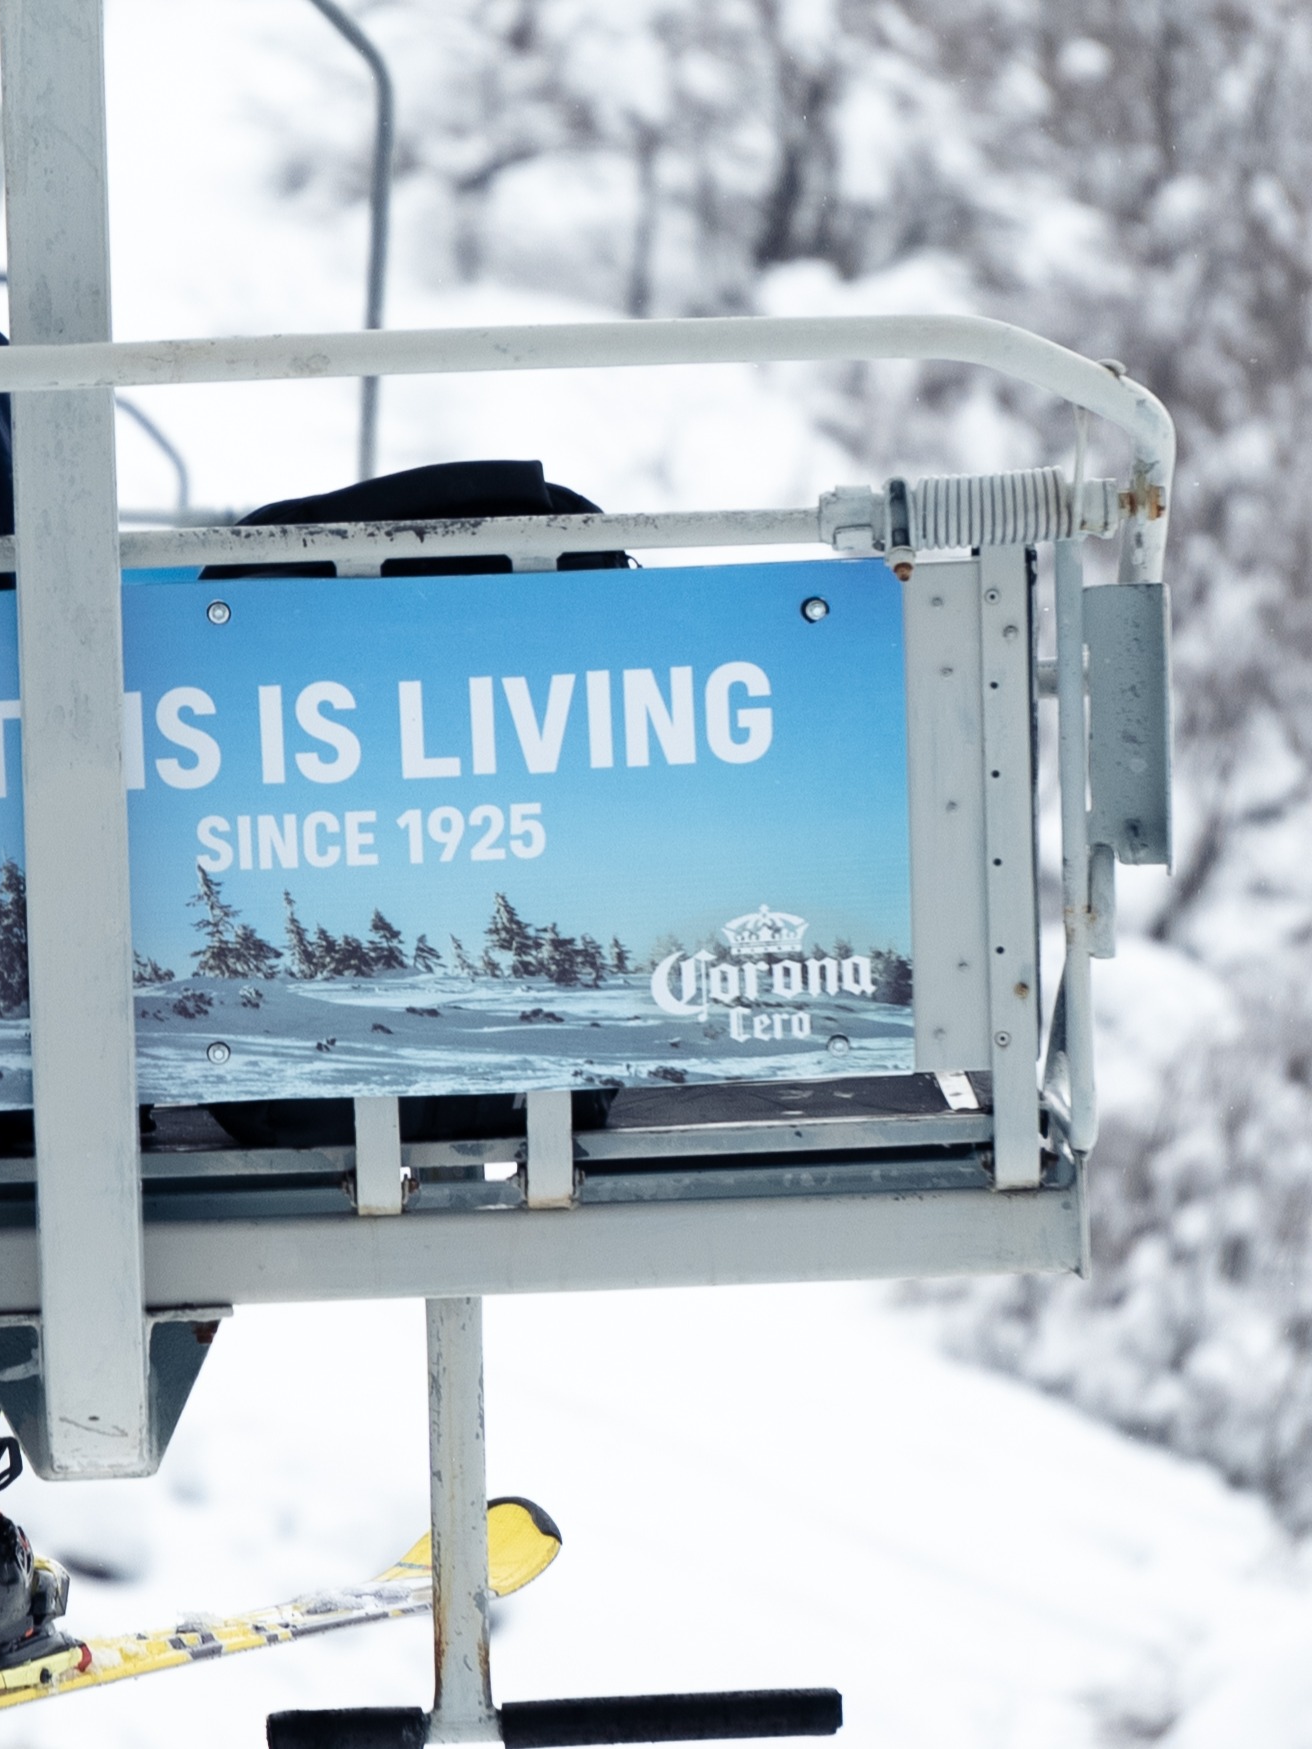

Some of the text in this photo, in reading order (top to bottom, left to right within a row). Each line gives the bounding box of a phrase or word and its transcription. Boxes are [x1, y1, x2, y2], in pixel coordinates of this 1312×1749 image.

[258, 681, 361, 785] IS
[398, 661, 773, 780] LIVING
[195, 803, 546, 873] SINCE 1925
[650, 949, 877, 1023] Corona
[729, 1006, 812, 1043] Cero
